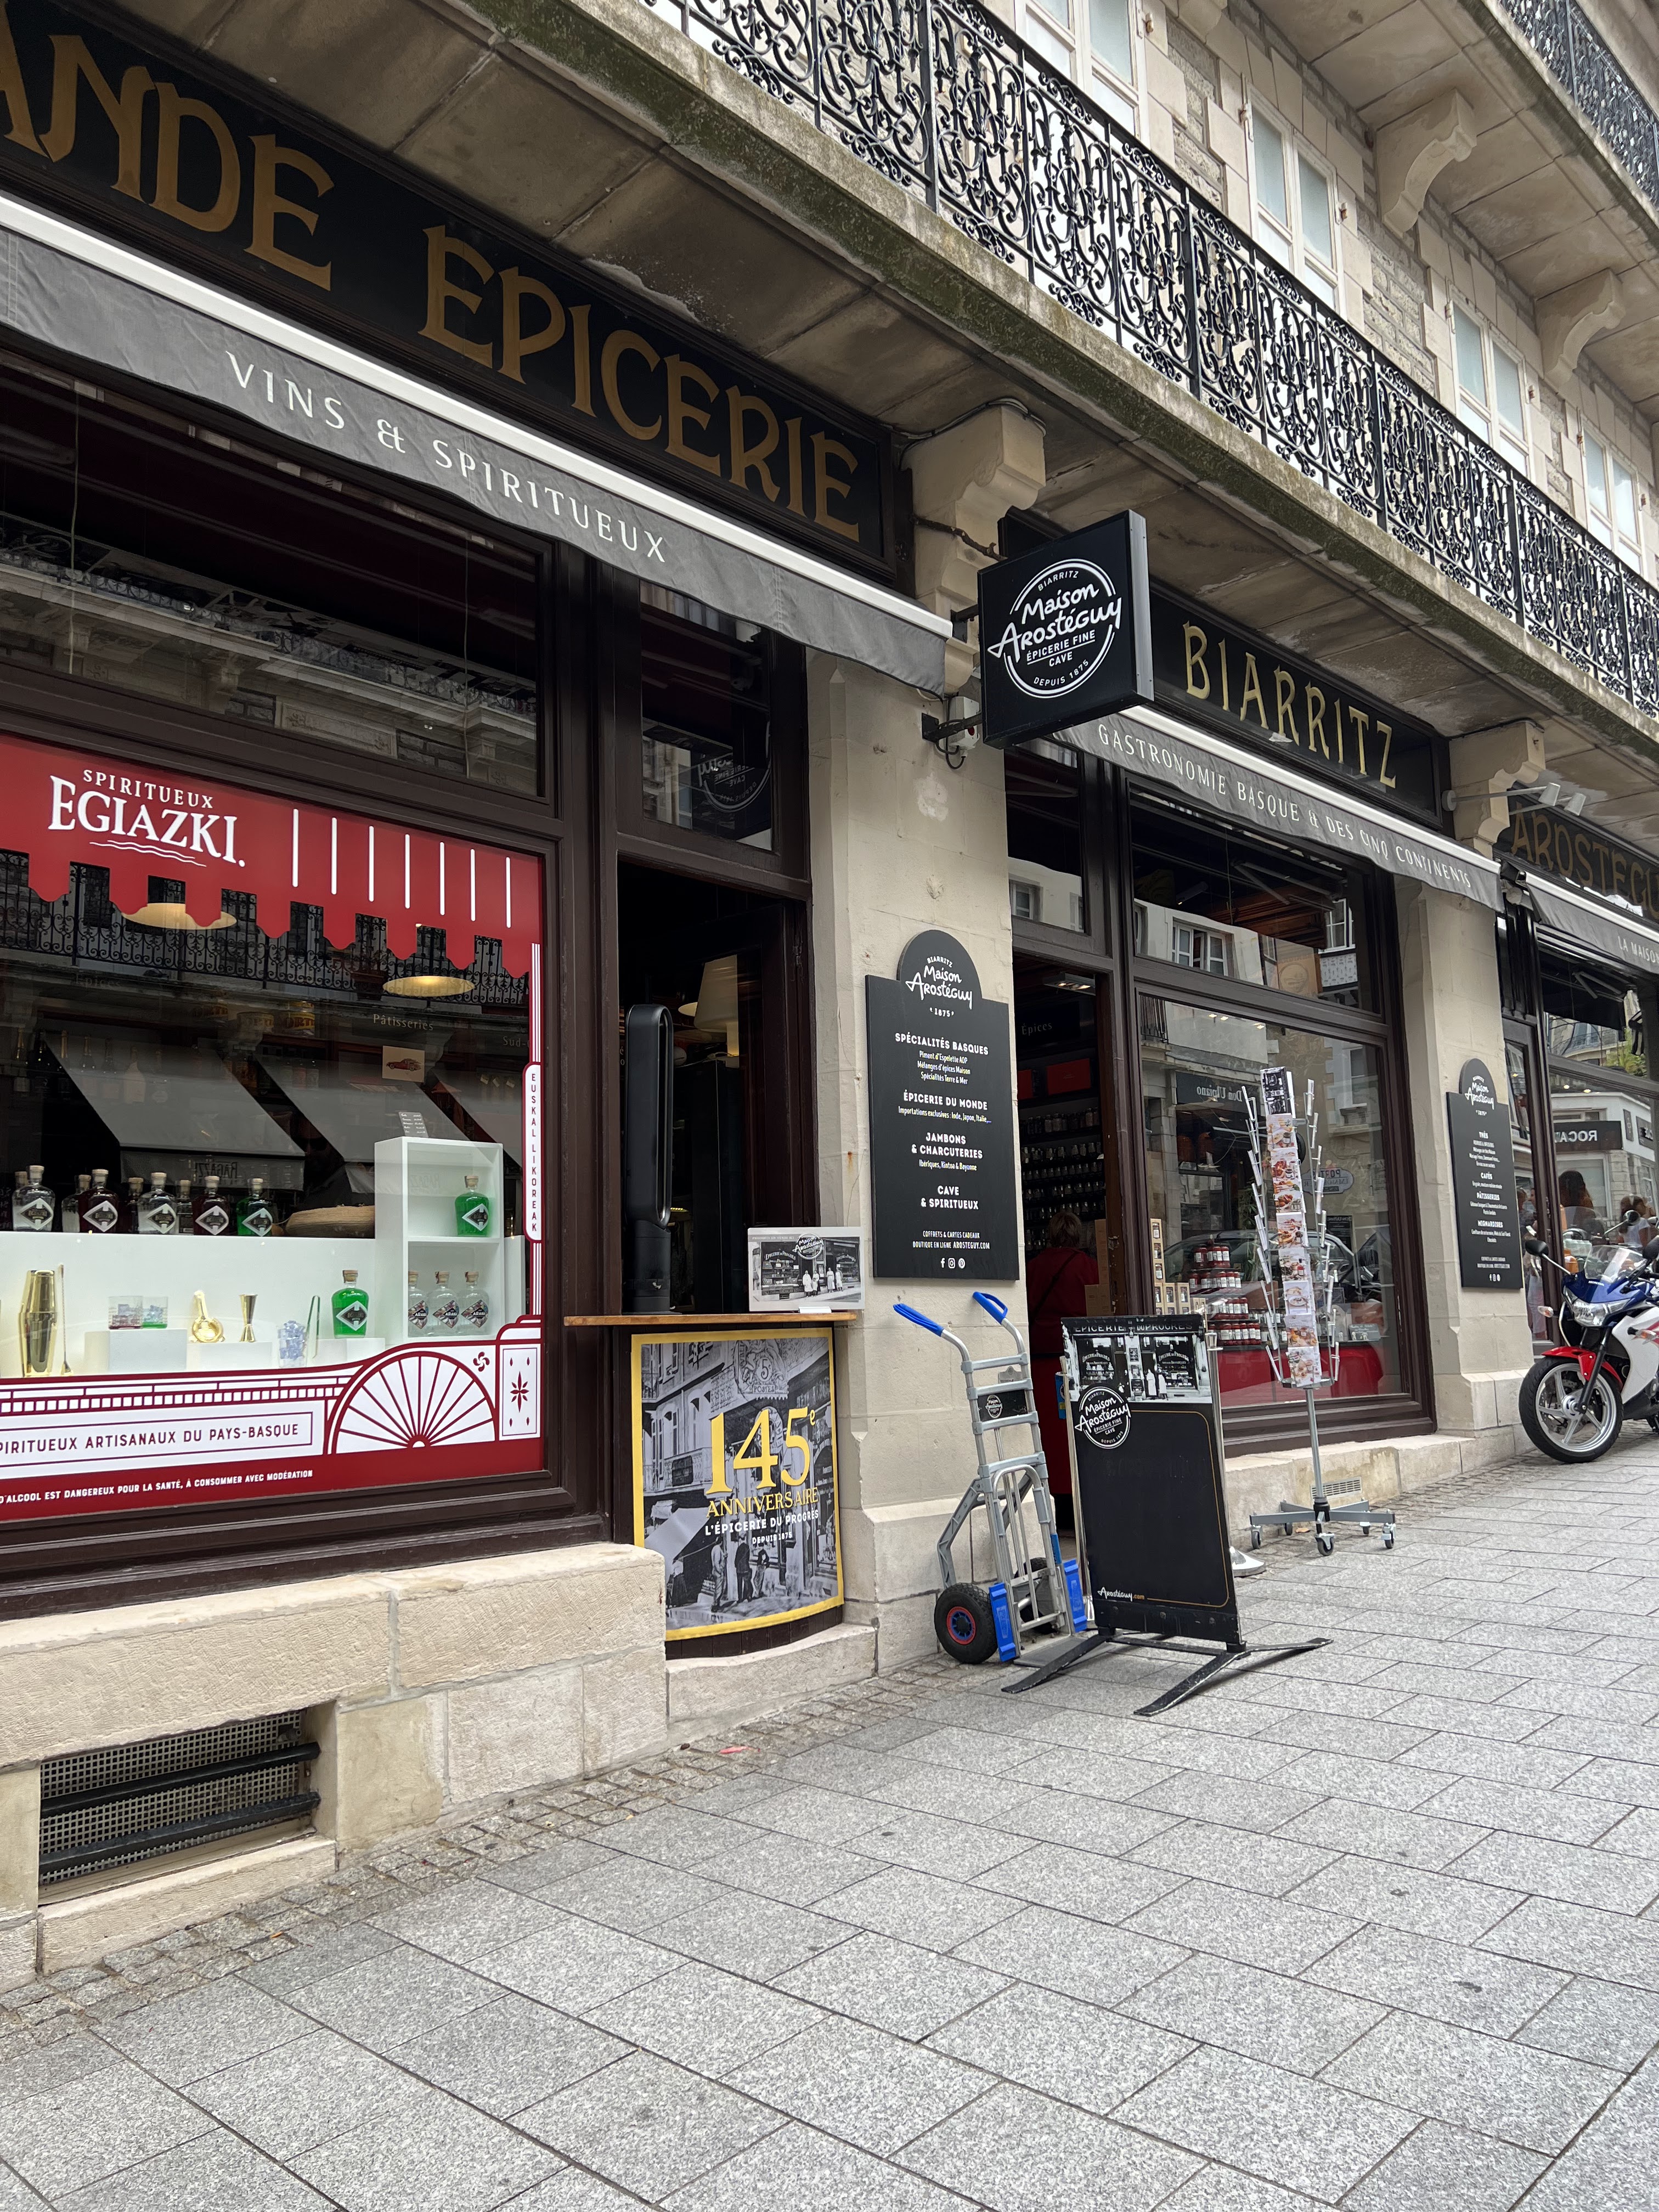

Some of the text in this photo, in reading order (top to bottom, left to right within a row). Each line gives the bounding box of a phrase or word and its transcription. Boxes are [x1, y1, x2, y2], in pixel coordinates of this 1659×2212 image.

[417, 225, 860, 543] EPICERIE
[225, 351, 665, 563] VINS & SPIRITUEUX
[1037, 570, 1079, 592] BIARRITZ
[1021, 583, 1100, 624] Maison
[1026, 629, 1096, 662] ÉPICERIE FINE
[1049, 652, 1073, 667] CAVE
[1034, 659, 1089, 686] DEPUIS 1875
[1182, 619, 1397, 789] BIARRITZ
[83, 769, 214, 809] SPIRITUEUX
[1098, 724, 1471, 888] GASTRONOMIE BASQUE & DES CINQ CONTINENTS
[1617, 935, 1628, 952] LA
[927, 956, 953, 968] BIARRITZ
[923, 965, 962, 984] Maison
[373, 1014, 434, 1031] Pâtisseries
[1021, 1022, 1053, 1035] Épices
[895, 1031, 989, 1056] SPÉCIALITÉS BASQUES
[919, 1050, 935, 1059] Piment
[935, 1053, 958, 1063] d'Espelette
[917, 1060, 970, 1075] Mélanges d'épices Maison
[921, 1071, 944, 1081] Spécialités
[944, 1075, 955, 1083] Terre
[960, 1076, 968, 1085] Mer
[903, 1089, 988, 1110] ÉPICERIE DU MONDE
[898, 1105, 927, 1116] Importations
[928, 1109, 949, 1119] exclusives
[963, 1113, 976, 1123] Japon,
[926, 1132, 967, 1145] JAMBONS
[911, 1144, 983, 1159] & CHARCUTERIES
[919, 1159, 941, 1170] Ibériques,
[941, 1161, 955, 1170] Kintoa
[960, 1163, 977, 1172] Bayonne
[937, 1185, 960, 1196] CAVE
[921, 1198, 979, 1210] & SPIRITUEUX
[953, 1242, 990, 1250] AROSTEGUY.COM
[1074, 1324, 1125, 1333] EPICERIE
[754, 1385, 775, 1393] POSTES
[1085, 1397, 1116, 1417] Maison
[1111, 1417, 1122, 1425] FINE
[85, 1431, 176, 1449] ARTISANAUX
[184, 1430, 201, 1442] DU
[210, 1424, 298, 1441] PAYS-BASQUE
[44, 1491, 61, 1500] EST
[64, 1486, 114, 1499] DANGEREUX
[117, 1484, 140, 1493] POUR
[143, 1483, 153, 1491] LA
[156, 1479, 184, 1490] SANTÉ,
[186, 1479, 191, 1488] À
[194, 1476, 242, 1487] CONSOMMER
[245, 1474, 264, 1483] AVEC
[267, 1470, 313, 1481] MODÉRATION
[706, 1487, 820, 1519] ANNIVERSAIRE
[706, 1508, 819, 1536] L'ÉPICERIE DU PROGRÈS
[752, 1532, 793, 1544] DEPUIS 1875
